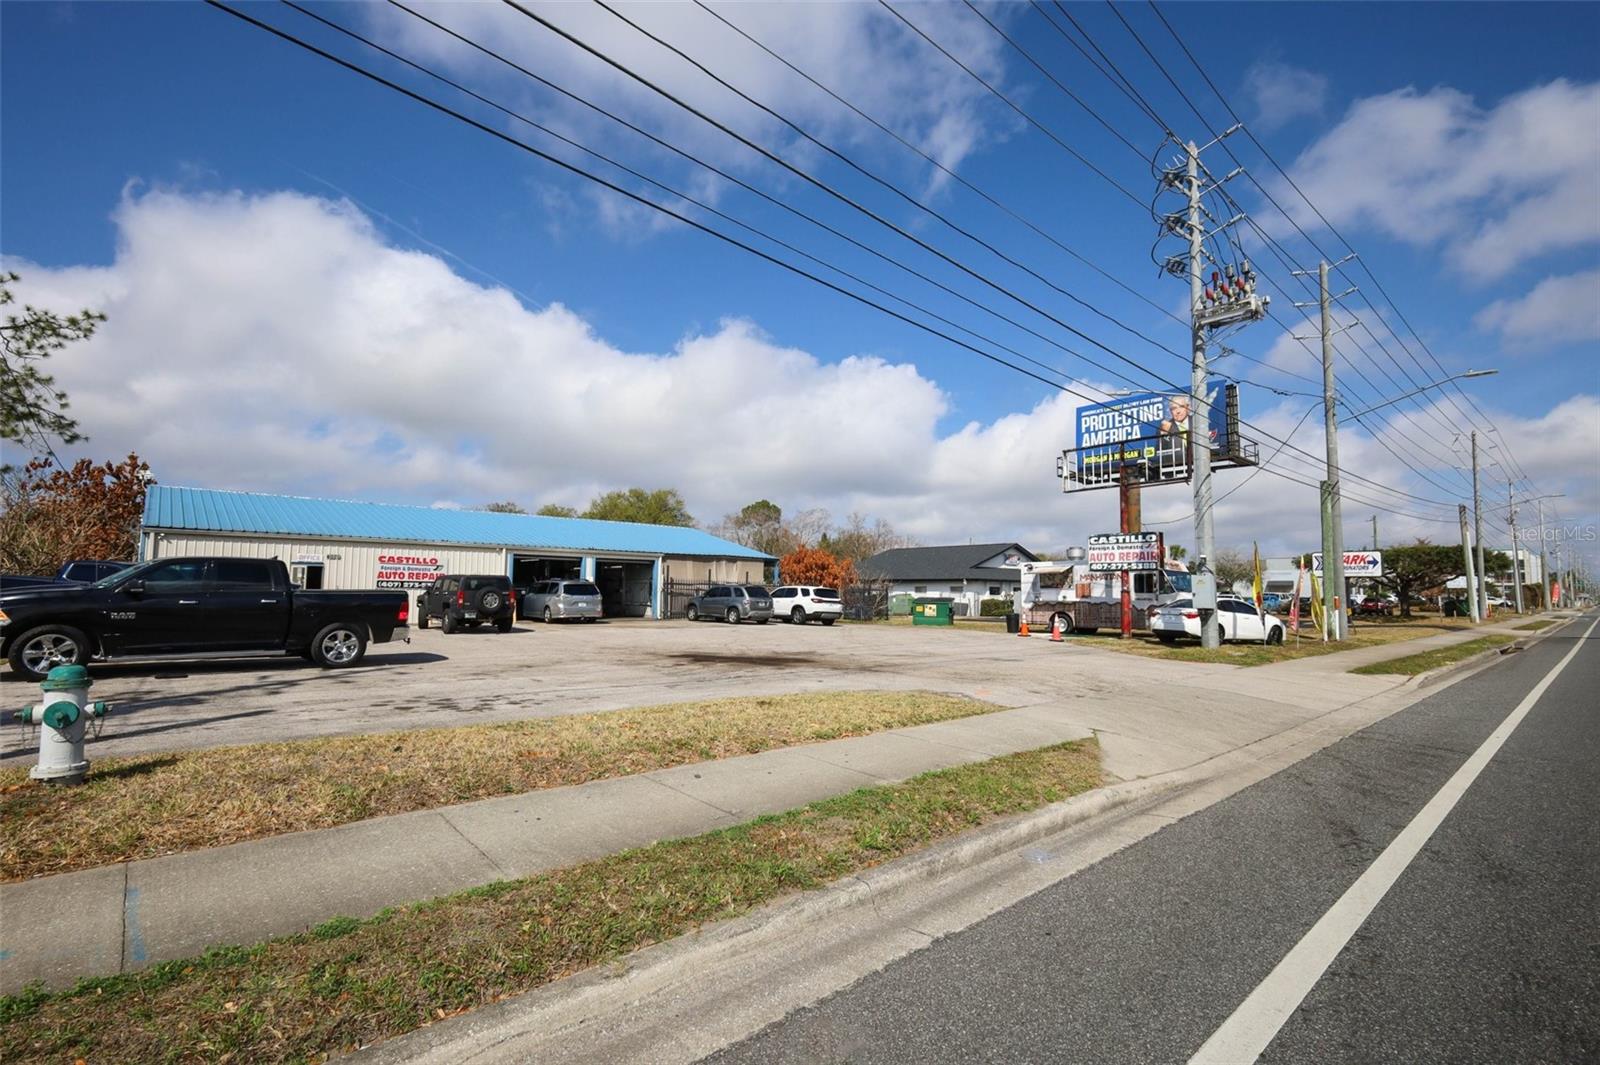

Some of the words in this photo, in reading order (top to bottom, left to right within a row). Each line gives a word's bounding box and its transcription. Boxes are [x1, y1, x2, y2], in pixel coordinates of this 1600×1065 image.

[1081, 402, 1163, 432] PROTECTING
[1082, 425, 1141, 447] AMERICA
[1090, 535, 1157, 544] CASTILLO
[378, 555, 438, 564] CASTILLO
[1090, 552, 1116, 561] AUTO
[1119, 551, 1157, 561] REPAIR
[377, 571, 405, 580] AUTO
